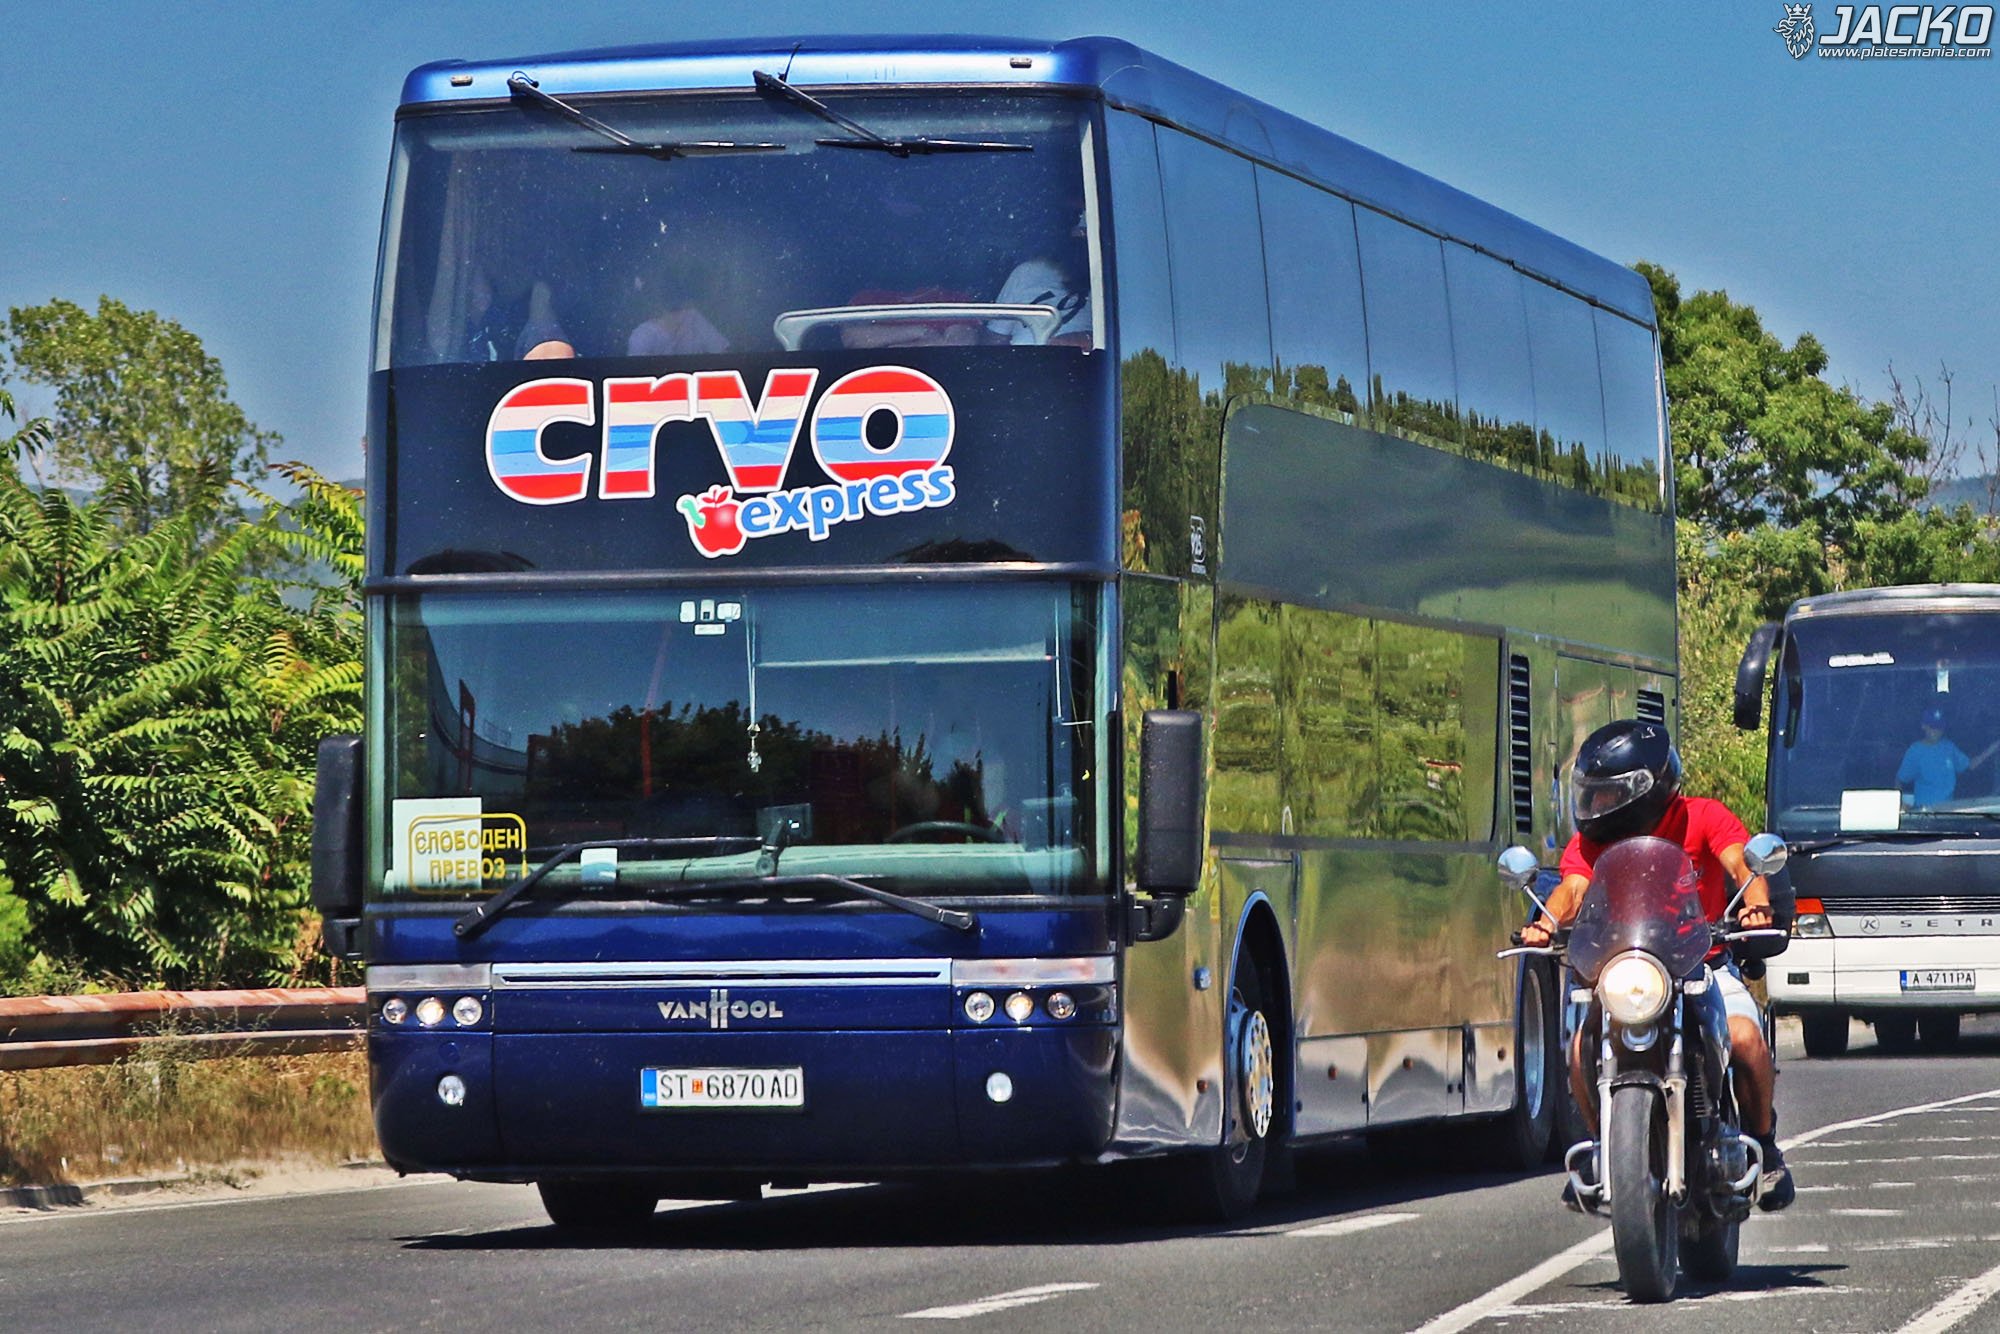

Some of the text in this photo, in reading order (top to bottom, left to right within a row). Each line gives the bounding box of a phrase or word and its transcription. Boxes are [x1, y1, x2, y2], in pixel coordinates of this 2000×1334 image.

[485, 365, 955, 505] crvo
[737, 467, 956, 542] express
[415, 827, 520, 854] СЛОБОДЕН
[430, 857, 506, 883] ПРЕВОЗ
[660, 1074, 688, 1100] ST
